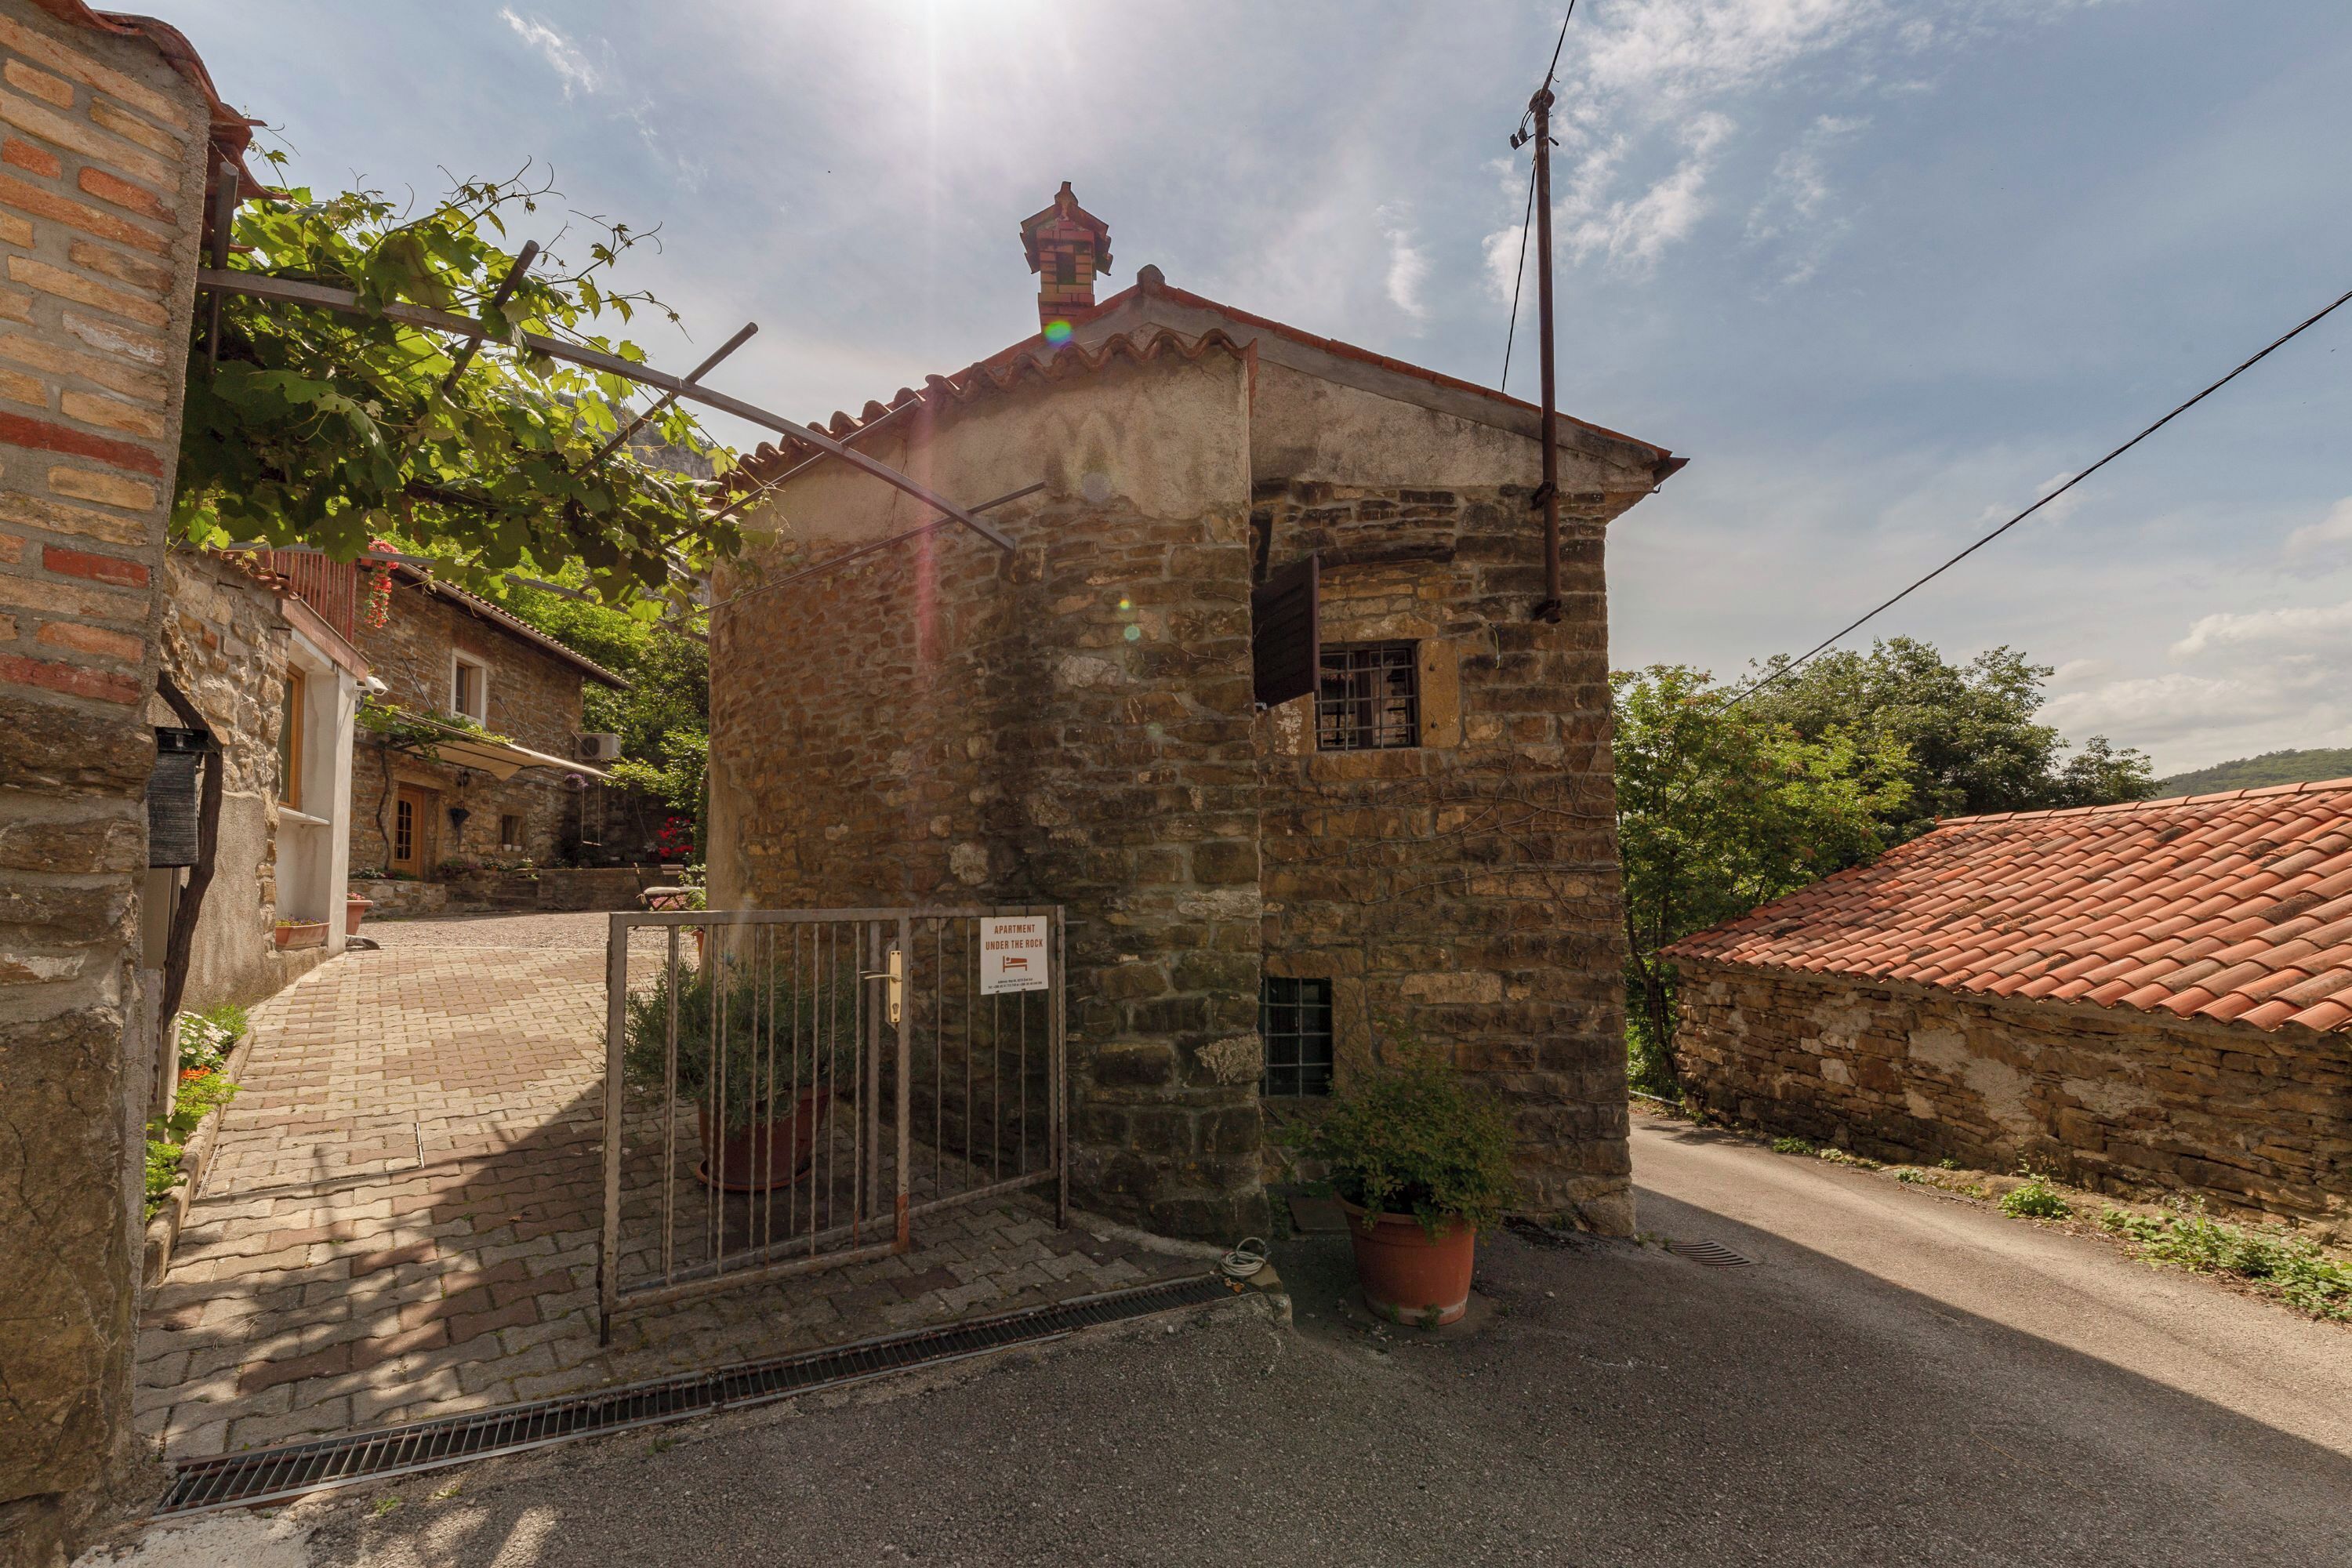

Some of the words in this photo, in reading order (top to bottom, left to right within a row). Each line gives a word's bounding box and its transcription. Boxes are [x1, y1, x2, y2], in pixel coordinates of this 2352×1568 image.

[994, 924, 1035, 934] APARTMENT
[985, 941, 1009, 950] UNDER
[1011, 940, 1023, 949] THE
[1025, 939, 1043, 948] ROCK
